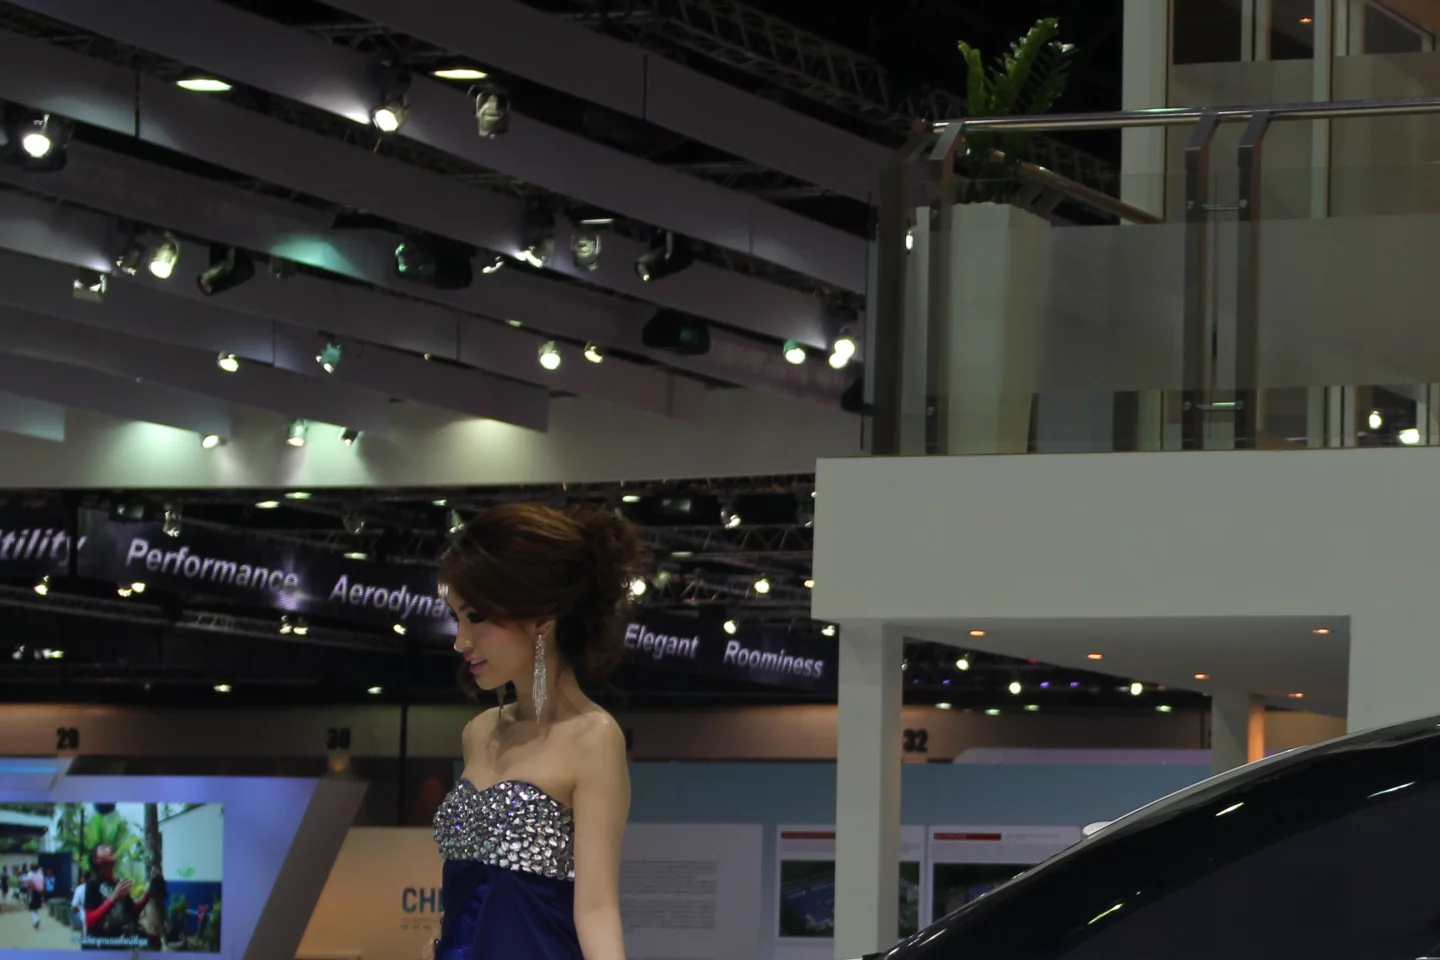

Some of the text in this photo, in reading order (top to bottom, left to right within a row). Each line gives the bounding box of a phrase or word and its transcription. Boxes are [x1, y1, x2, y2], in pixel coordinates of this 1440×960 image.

[0, 529, 87, 567] tility
[125, 538, 300, 595] Performance
[330, 574, 452, 619] Aerodyna
[623, 623, 700, 659] Elegant
[723, 640, 825, 678] Roominess
[56, 727, 80, 750] 29
[903, 728, 929, 753] 32
